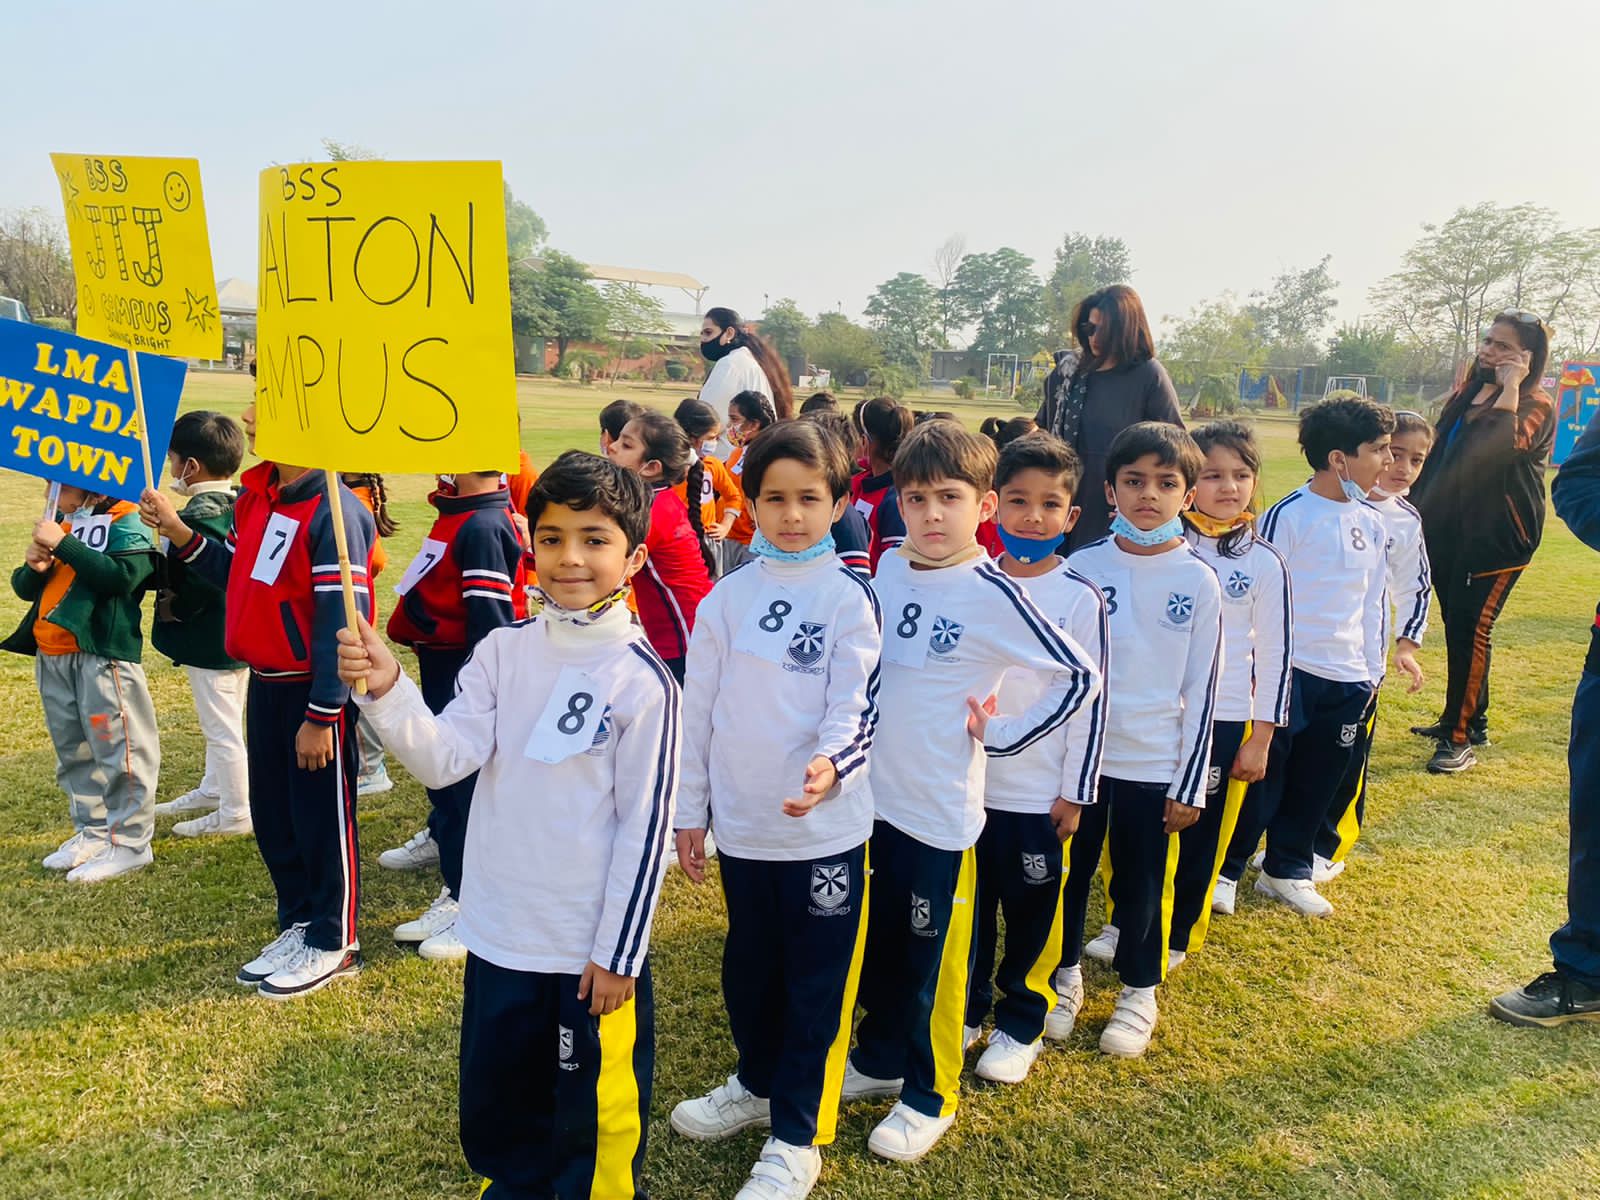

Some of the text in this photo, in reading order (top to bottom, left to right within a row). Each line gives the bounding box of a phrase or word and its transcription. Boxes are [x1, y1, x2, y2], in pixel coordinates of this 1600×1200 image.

[84, 158, 128, 192] BSS
[280, 168, 342, 206] BSS
[84, 205, 163, 287] JTJ
[260, 202, 475, 312] ALTON
[133, 333, 171, 351] BRIGHT
[34, 342, 130, 393] LMA
[259, 335, 458, 442] AMPUS
[0, 376, 143, 441] WAPDA
[11, 425, 133, 486] TOWN
[74, 525, 107, 548] 10
[269, 530, 287, 560] 7
[1350, 527, 1367, 551] 8
[418, 553, 436, 575] 7
[758, 599, 793, 633] 8
[896, 602, 922, 639] 8
[557, 691, 594, 736] 8
